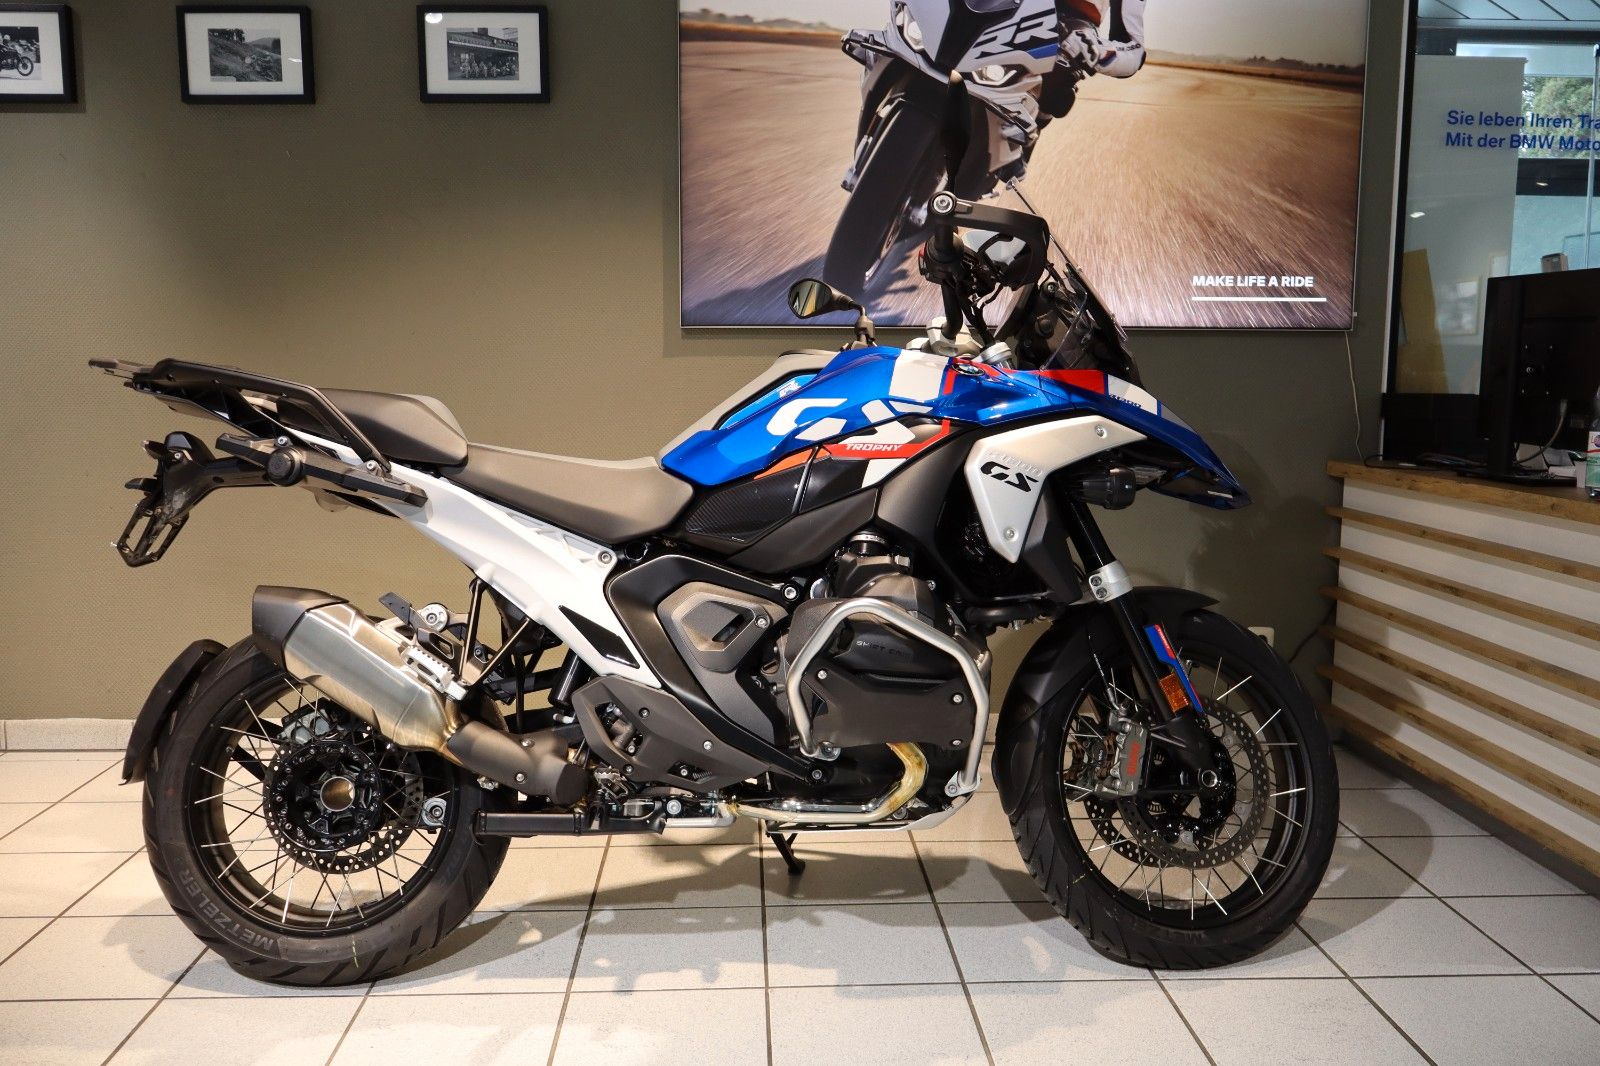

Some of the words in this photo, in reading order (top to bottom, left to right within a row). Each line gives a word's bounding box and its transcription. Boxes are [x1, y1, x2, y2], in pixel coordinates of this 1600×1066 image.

[1447, 110, 1474, 126] Sie
[1478, 111, 1525, 127] leben
[1530, 113, 1573, 128] Ihren
[1445, 132, 1473, 147] Mit
[1477, 133, 1506, 148] der
[1509, 134, 1555, 149] BMW
[1192, 275, 1234, 287] MAKE
[1236, 276, 1266, 287] LIFE
[1268, 276, 1279, 287] A
[1281, 276, 1314, 288] RIDE
[845, 442, 903, 452] TROPHY
[980, 461, 1040, 493] GS
[179, 869, 274, 951] METZELER
